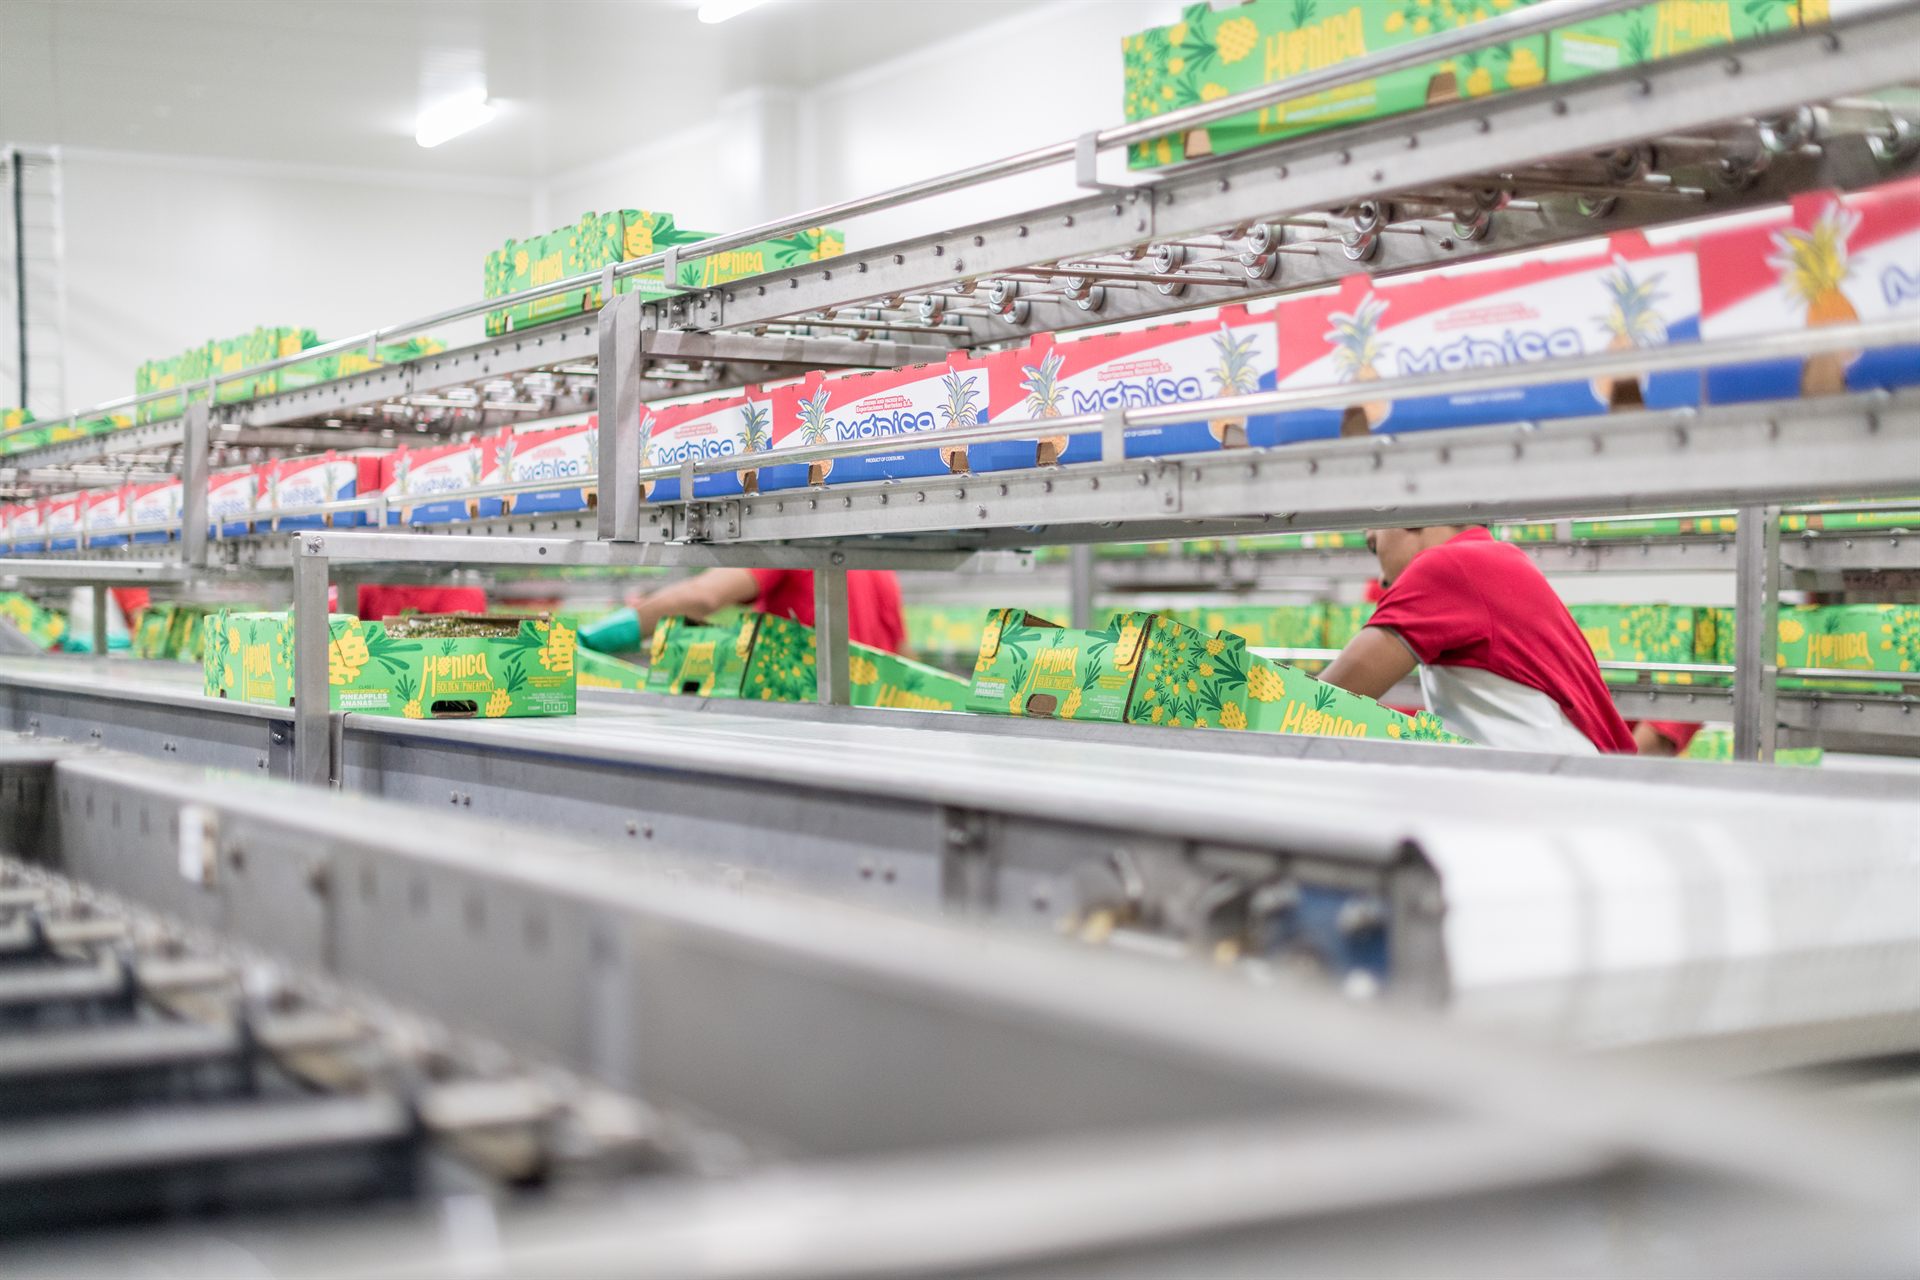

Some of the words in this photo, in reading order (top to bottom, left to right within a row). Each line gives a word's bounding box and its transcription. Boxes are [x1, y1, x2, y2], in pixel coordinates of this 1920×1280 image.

[1072, 377, 1202, 415] Mónica
[836, 410, 936, 440] Mónica
[658, 437, 735, 465] Mónica
[340, 692, 387, 700] PINEAPPLES
